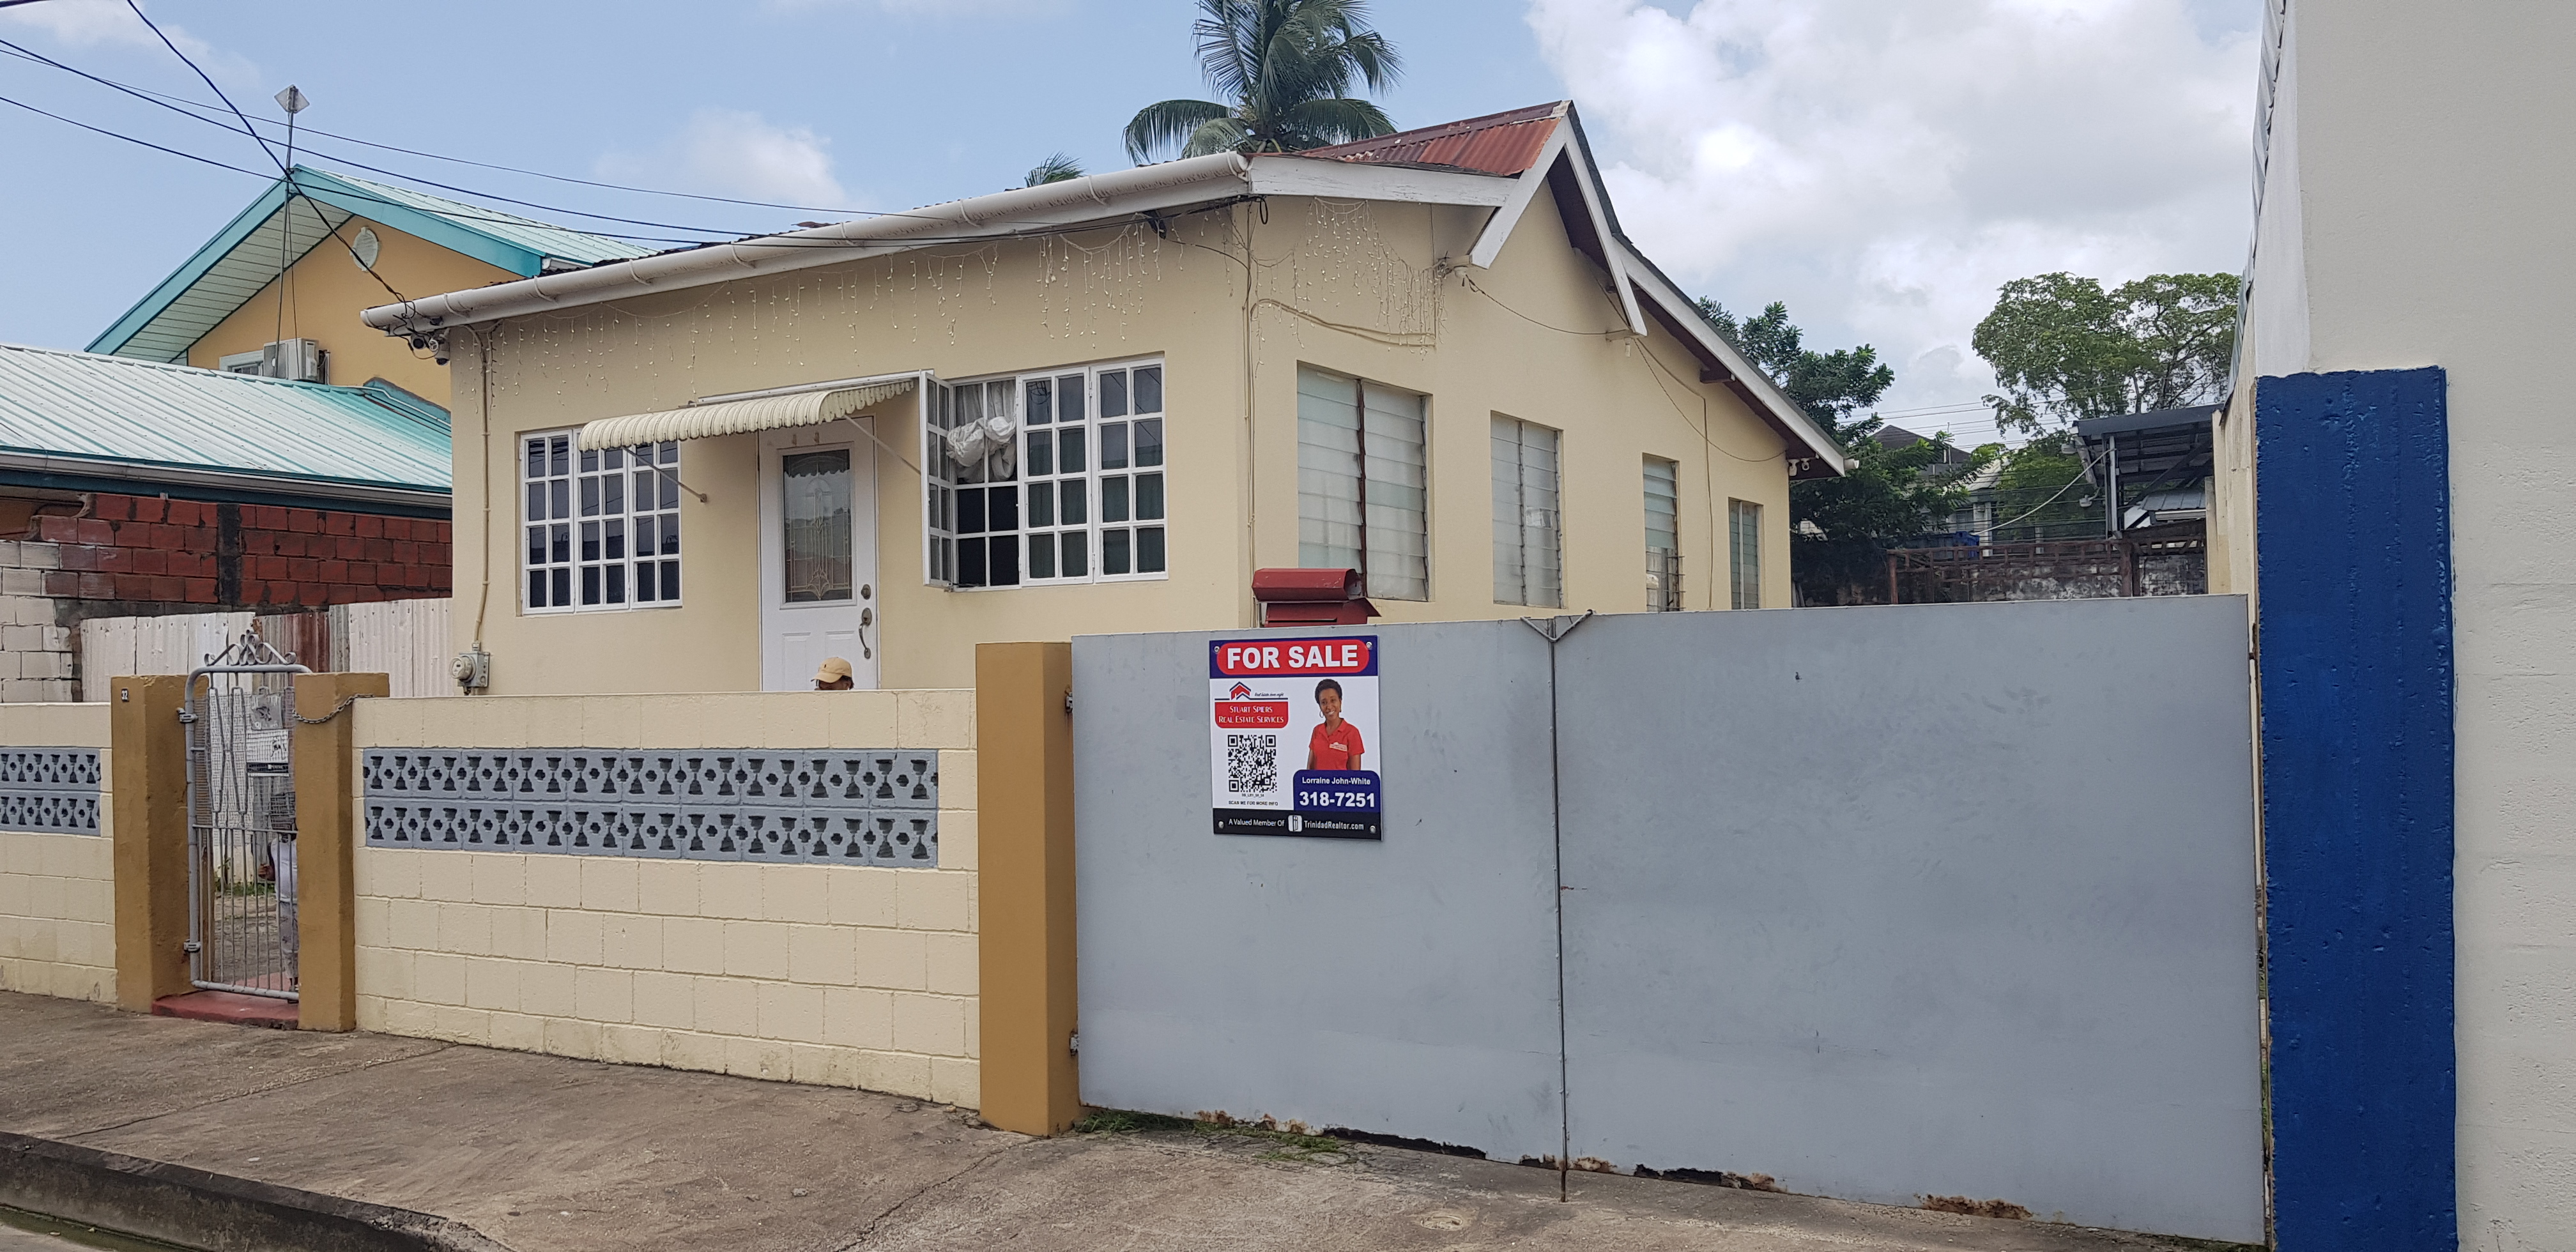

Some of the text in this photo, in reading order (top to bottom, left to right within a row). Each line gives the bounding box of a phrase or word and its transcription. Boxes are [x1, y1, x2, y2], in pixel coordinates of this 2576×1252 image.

[1227, 645, 1358, 669] FOR SALE
[1331, 777, 1371, 785] John-White
[1300, 791, 1375, 807] 318-7251
[1304, 820, 1364, 830] TrinidadRealtor.com
